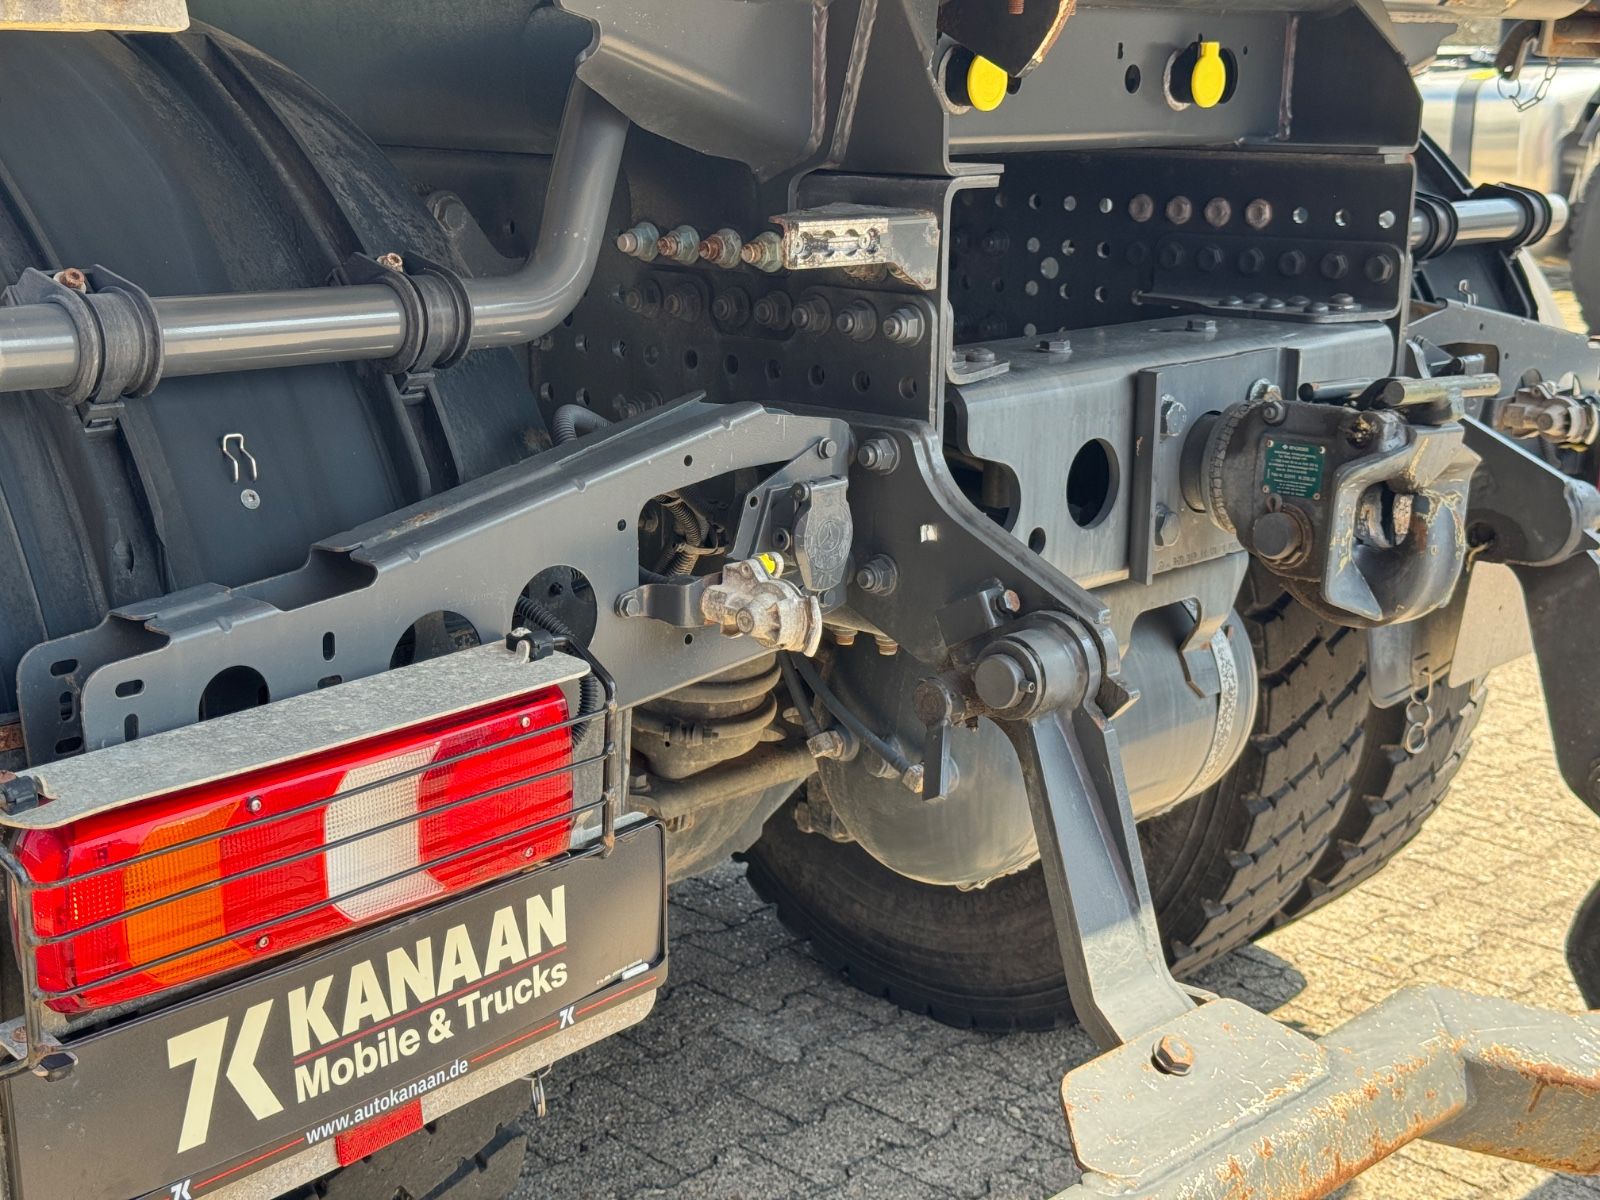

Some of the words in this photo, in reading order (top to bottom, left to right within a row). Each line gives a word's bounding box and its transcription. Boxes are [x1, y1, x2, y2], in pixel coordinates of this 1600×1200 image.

[288, 885, 567, 1056] KANAAN
[294, 1025, 421, 1104] Mobile
[427, 1007, 454, 1045] &
[457, 960, 568, 1028] Trucks
[305, 1058, 469, 1145] www.autokanaan.de
